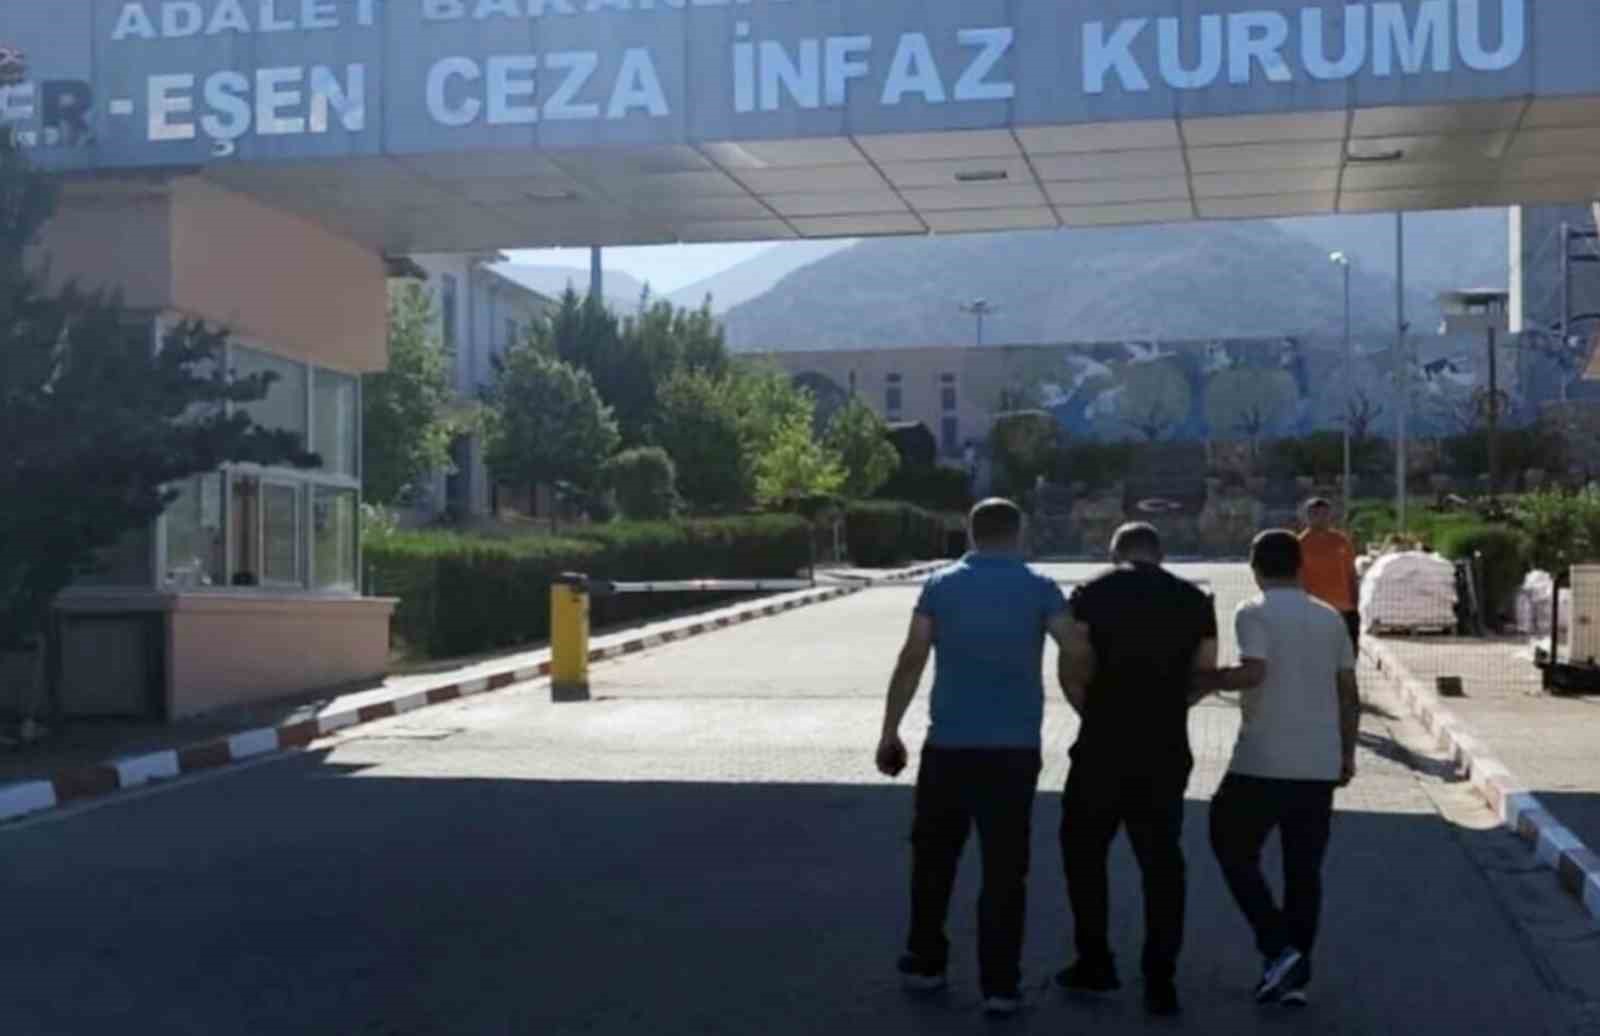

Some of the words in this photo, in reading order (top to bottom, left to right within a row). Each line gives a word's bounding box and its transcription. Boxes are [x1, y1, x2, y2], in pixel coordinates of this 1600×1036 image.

[425, 48, 670, 126] CEZA
[732, 21, 1015, 112] İNFAZ
[1081, 0, 1526, 94] KURUMU
